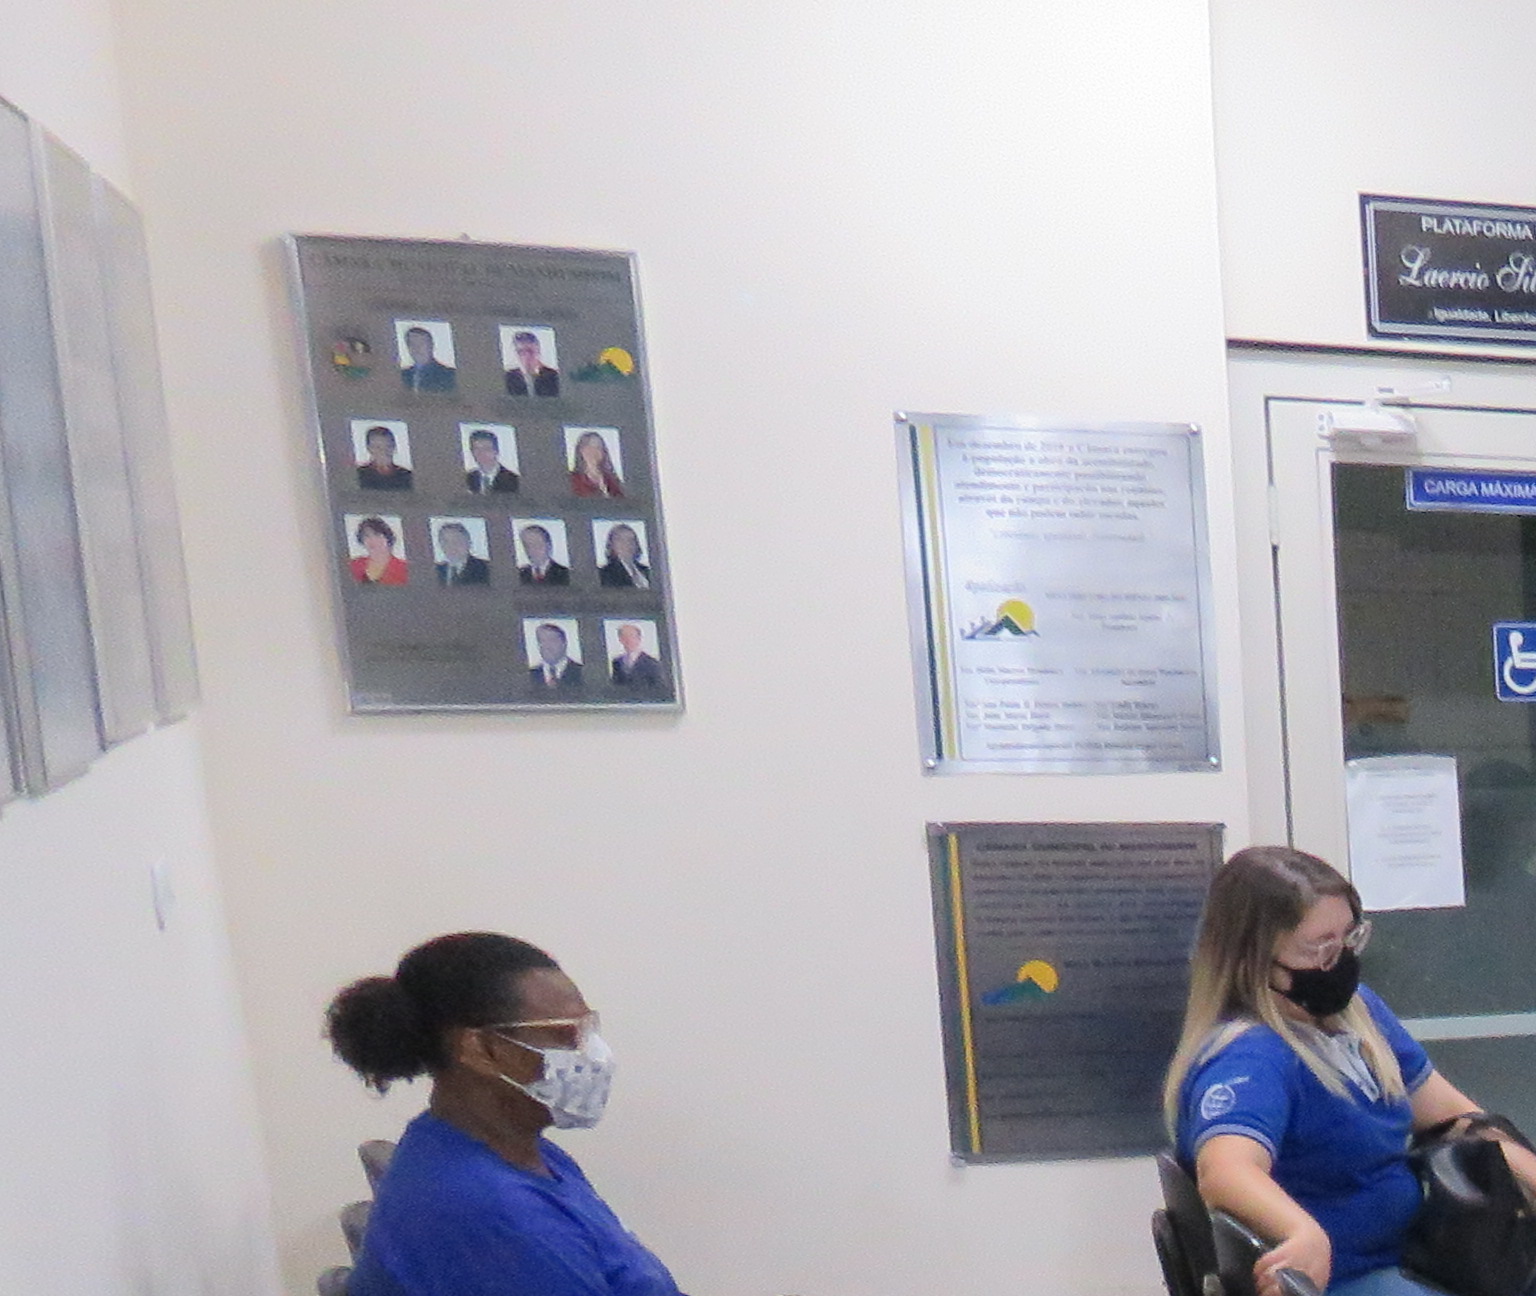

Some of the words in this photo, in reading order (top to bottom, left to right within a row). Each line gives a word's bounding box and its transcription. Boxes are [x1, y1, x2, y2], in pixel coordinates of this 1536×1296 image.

[1421, 215, 1533, 241] PLATAFORMA
[1398, 244, 1490, 290] Laercio
[1423, 478, 1478, 498] CARGA
